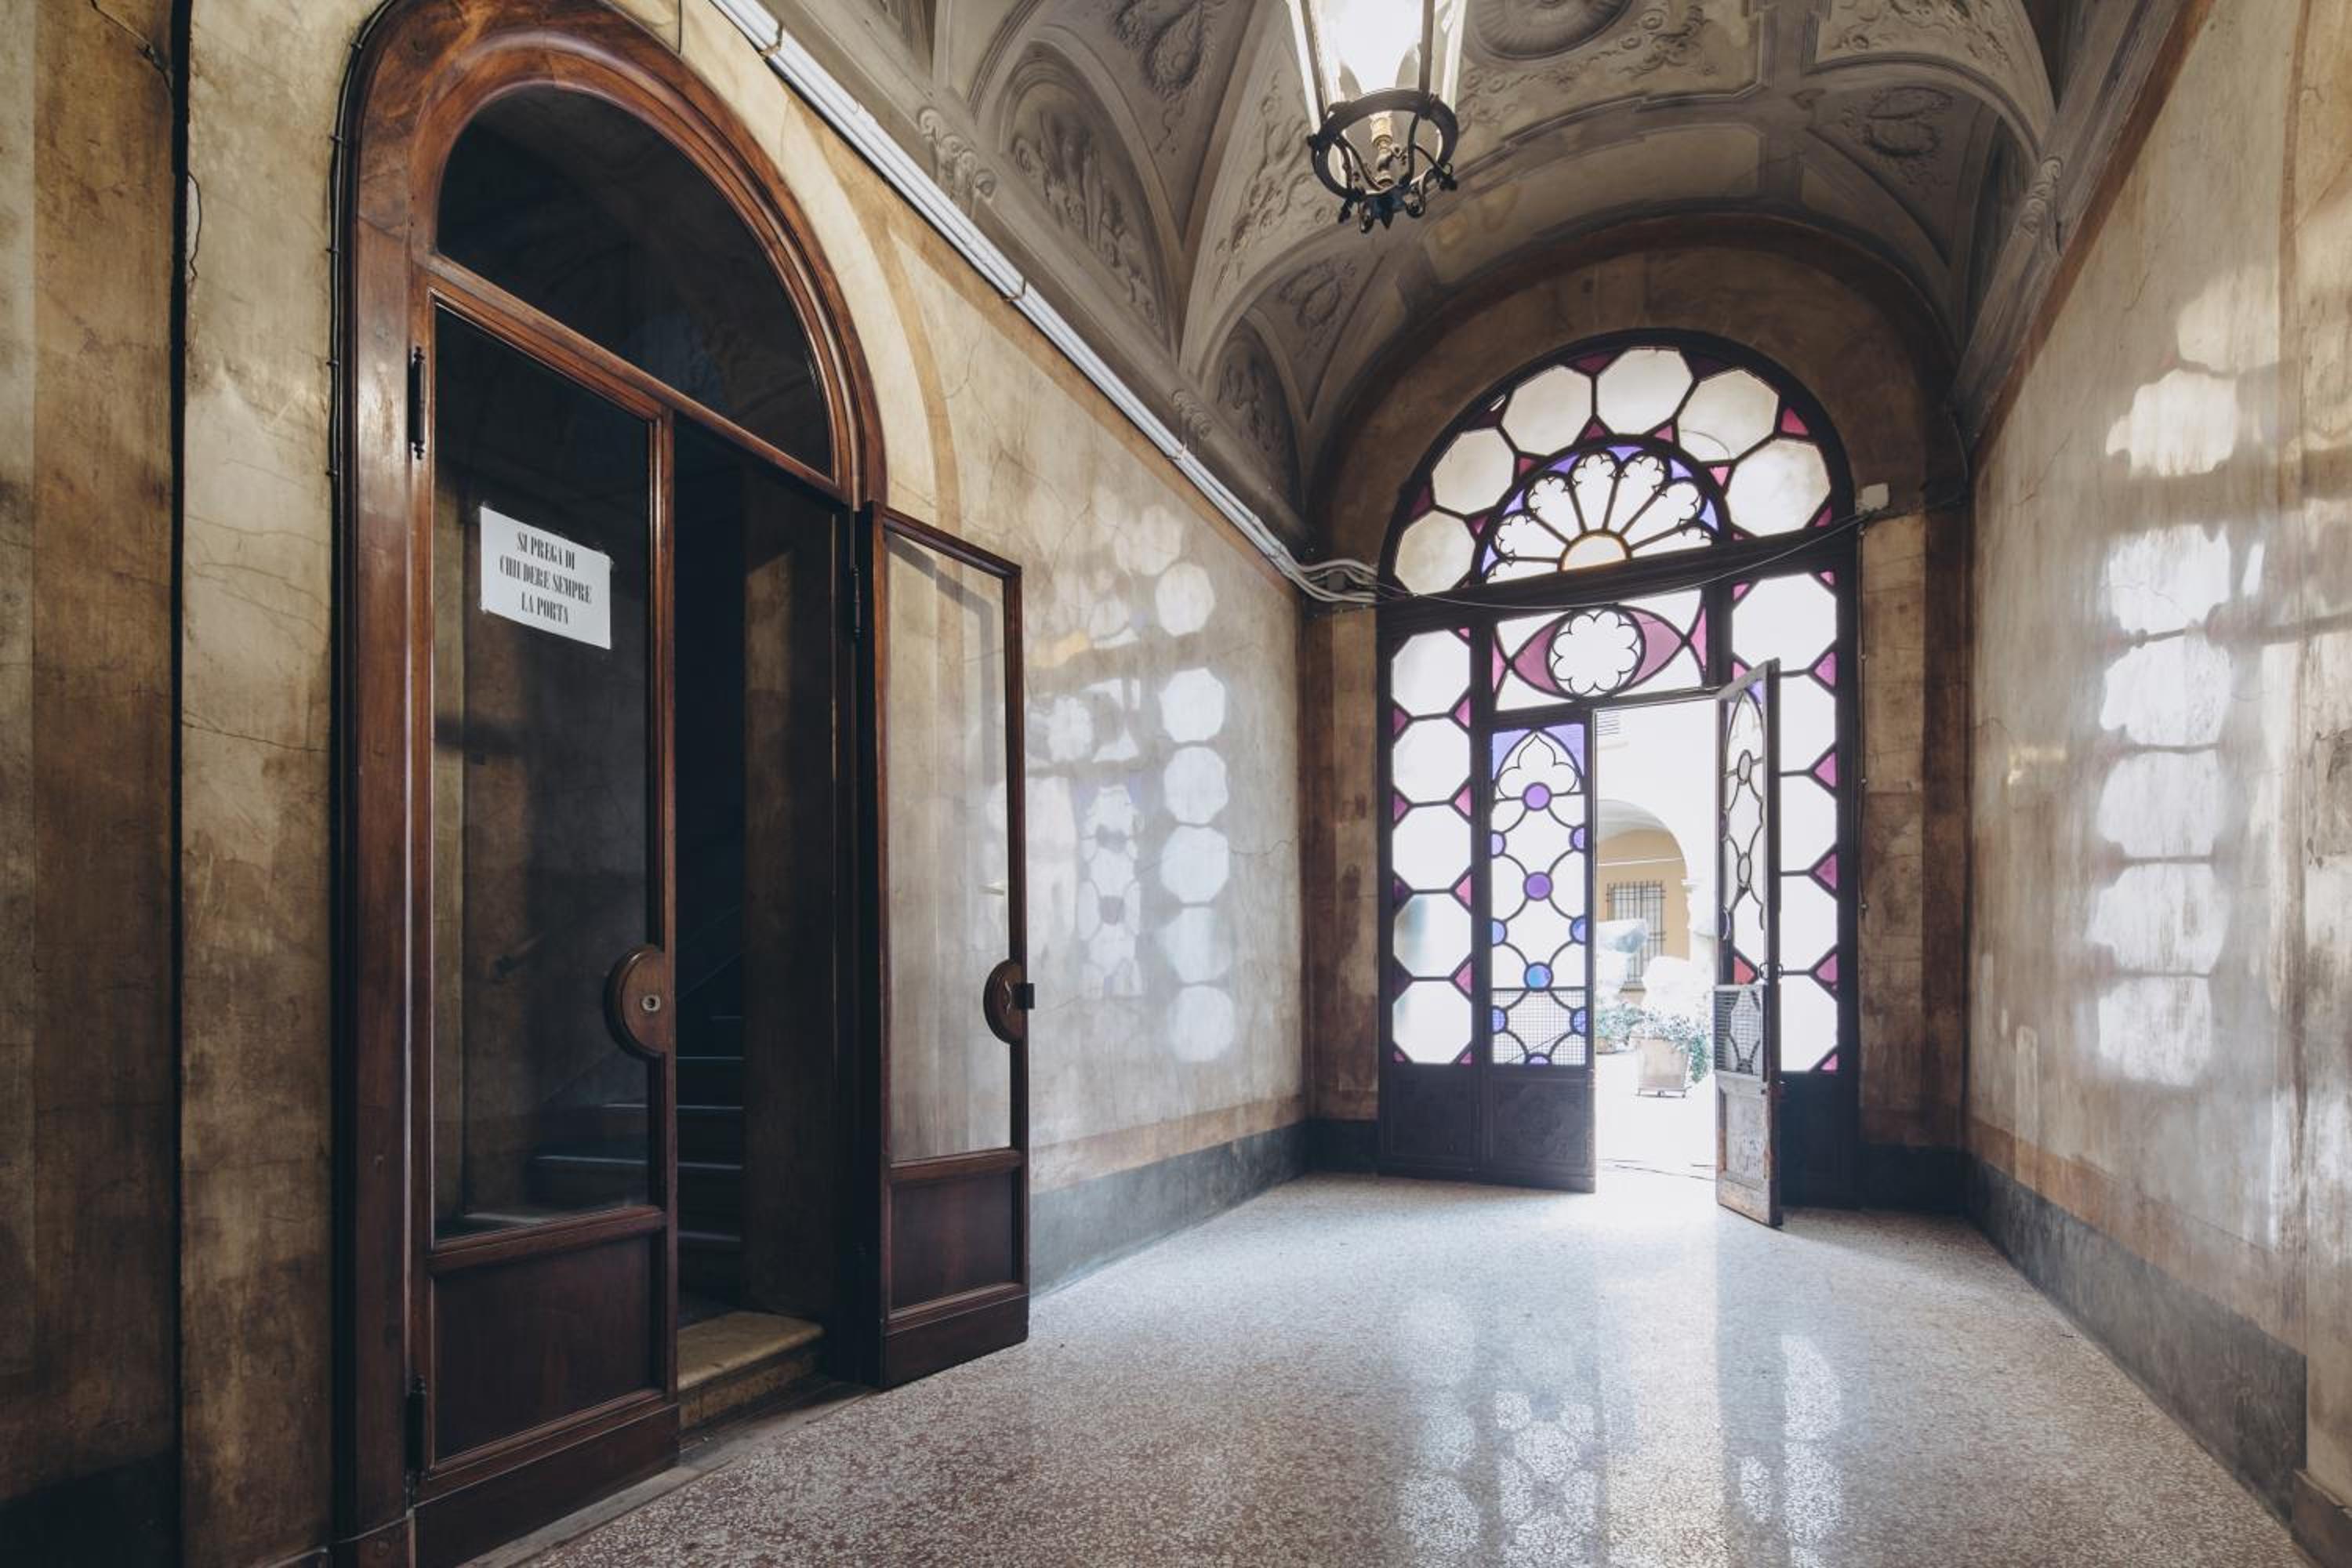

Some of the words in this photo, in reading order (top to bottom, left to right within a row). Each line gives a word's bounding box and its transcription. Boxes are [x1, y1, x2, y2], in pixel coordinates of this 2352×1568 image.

[517, 531, 528, 553] SI
[531, 535, 562, 565] PREGA
[565, 550, 575, 571] DI
[499, 554, 550, 590] CHIUDERE
[553, 573, 592, 604] SEMPRE
[521, 591, 534, 613] LA
[537, 597, 568, 624] PORTA
